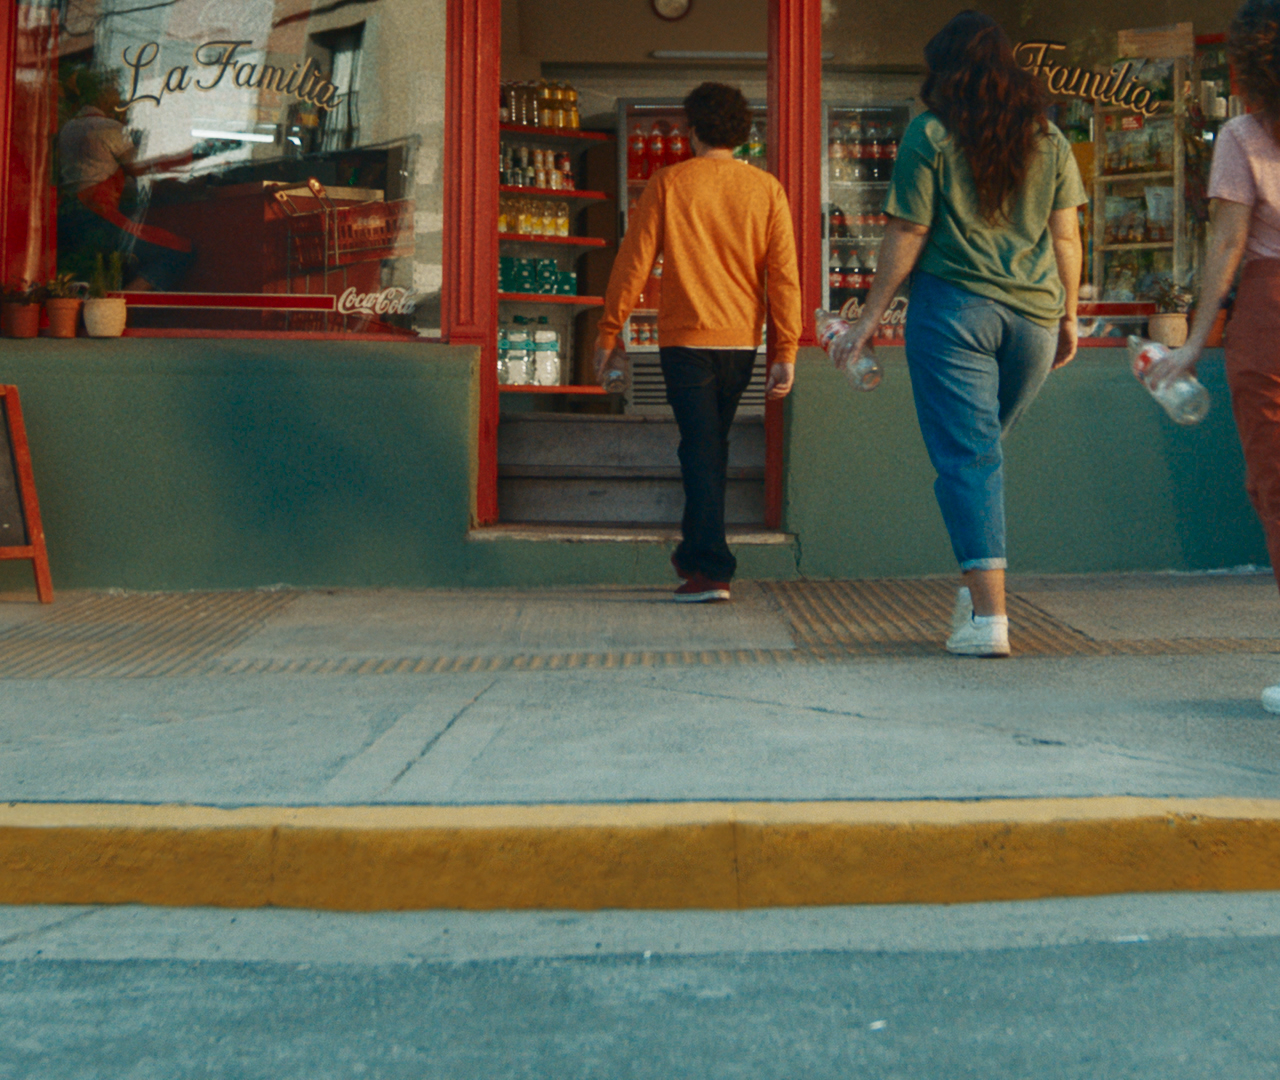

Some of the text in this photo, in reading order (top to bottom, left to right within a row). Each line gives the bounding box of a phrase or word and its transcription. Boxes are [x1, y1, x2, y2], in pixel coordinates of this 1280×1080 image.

[114, 39, 345, 111] La Familia
[337, 286, 418, 316] Coca-Cola
